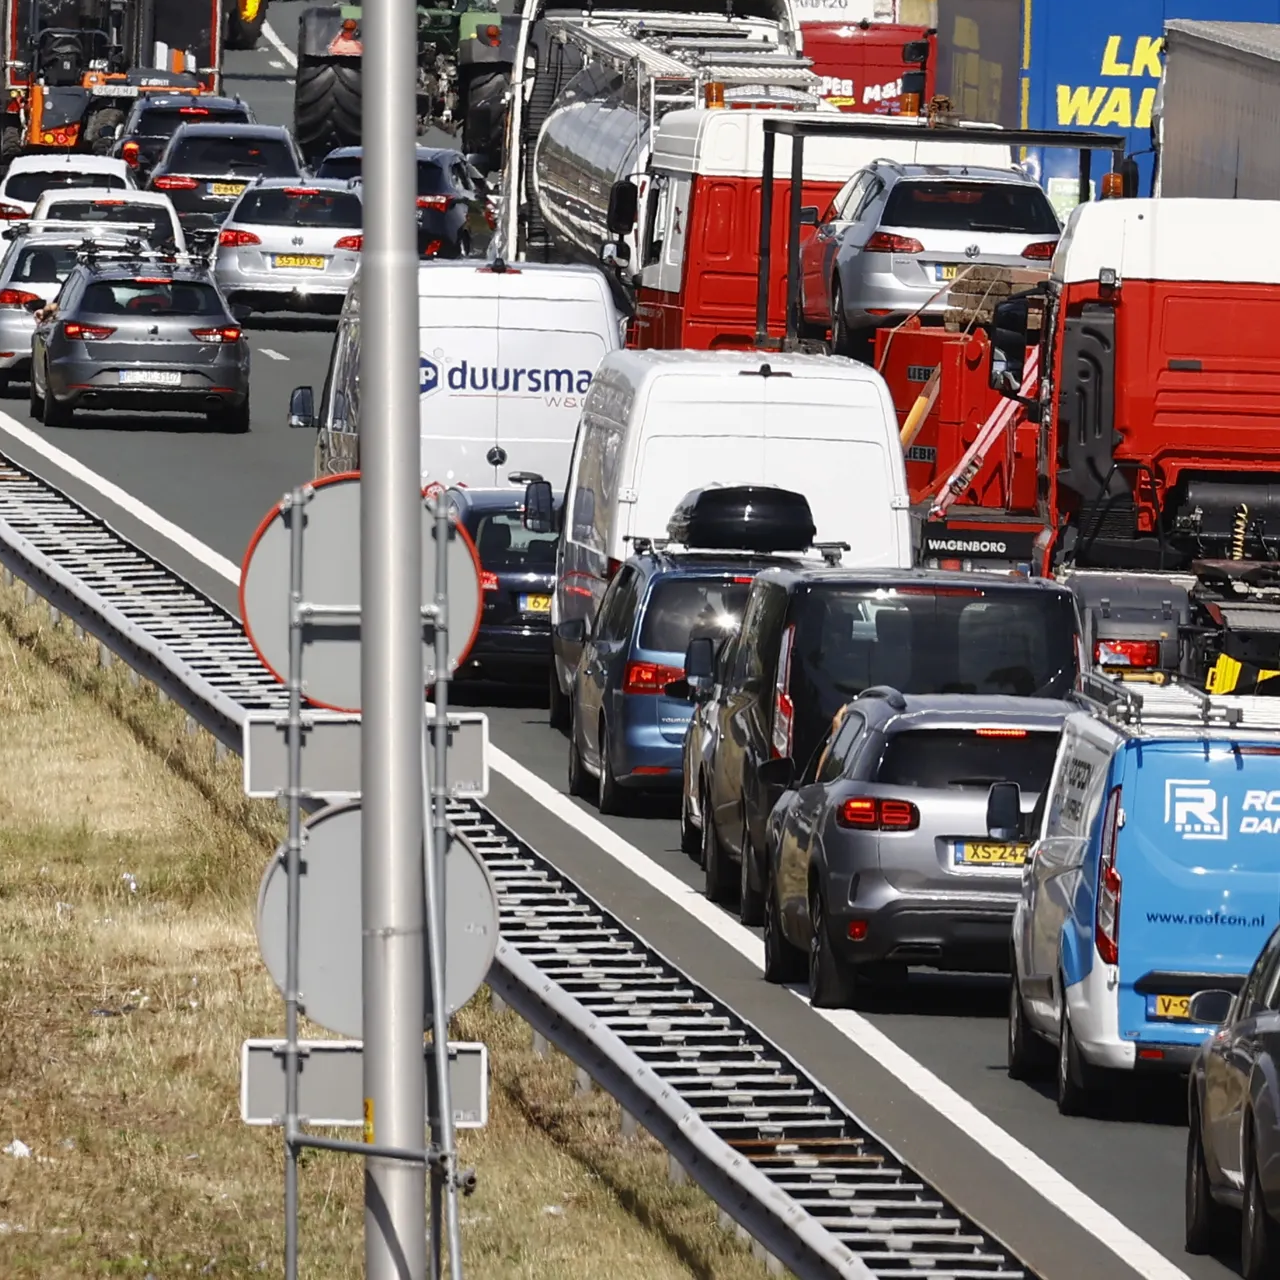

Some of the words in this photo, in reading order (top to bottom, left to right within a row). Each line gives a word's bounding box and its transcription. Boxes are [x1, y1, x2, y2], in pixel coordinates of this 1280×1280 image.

[447, 360, 593, 394] duursma
[907, 367, 936, 381] LIEB
[927, 539, 1007, 553] WAGENBORG
[1146, 911, 1266, 928] www.roofcon.nl
